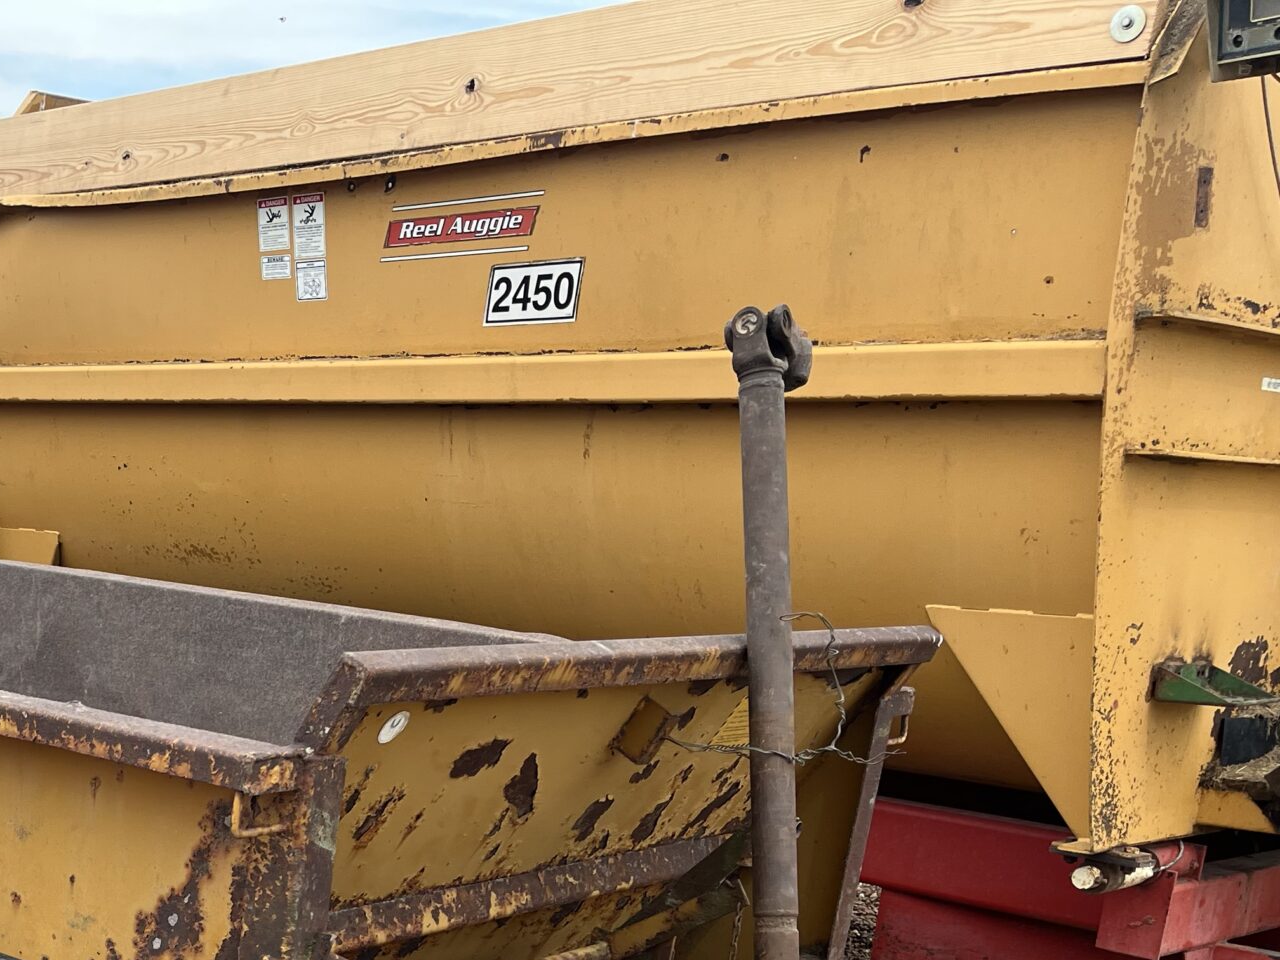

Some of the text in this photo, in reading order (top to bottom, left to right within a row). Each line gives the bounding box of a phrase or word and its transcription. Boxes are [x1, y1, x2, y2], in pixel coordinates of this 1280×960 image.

[398, 211, 524, 239] Reel Auggie
[491, 271, 575, 313] 2450
